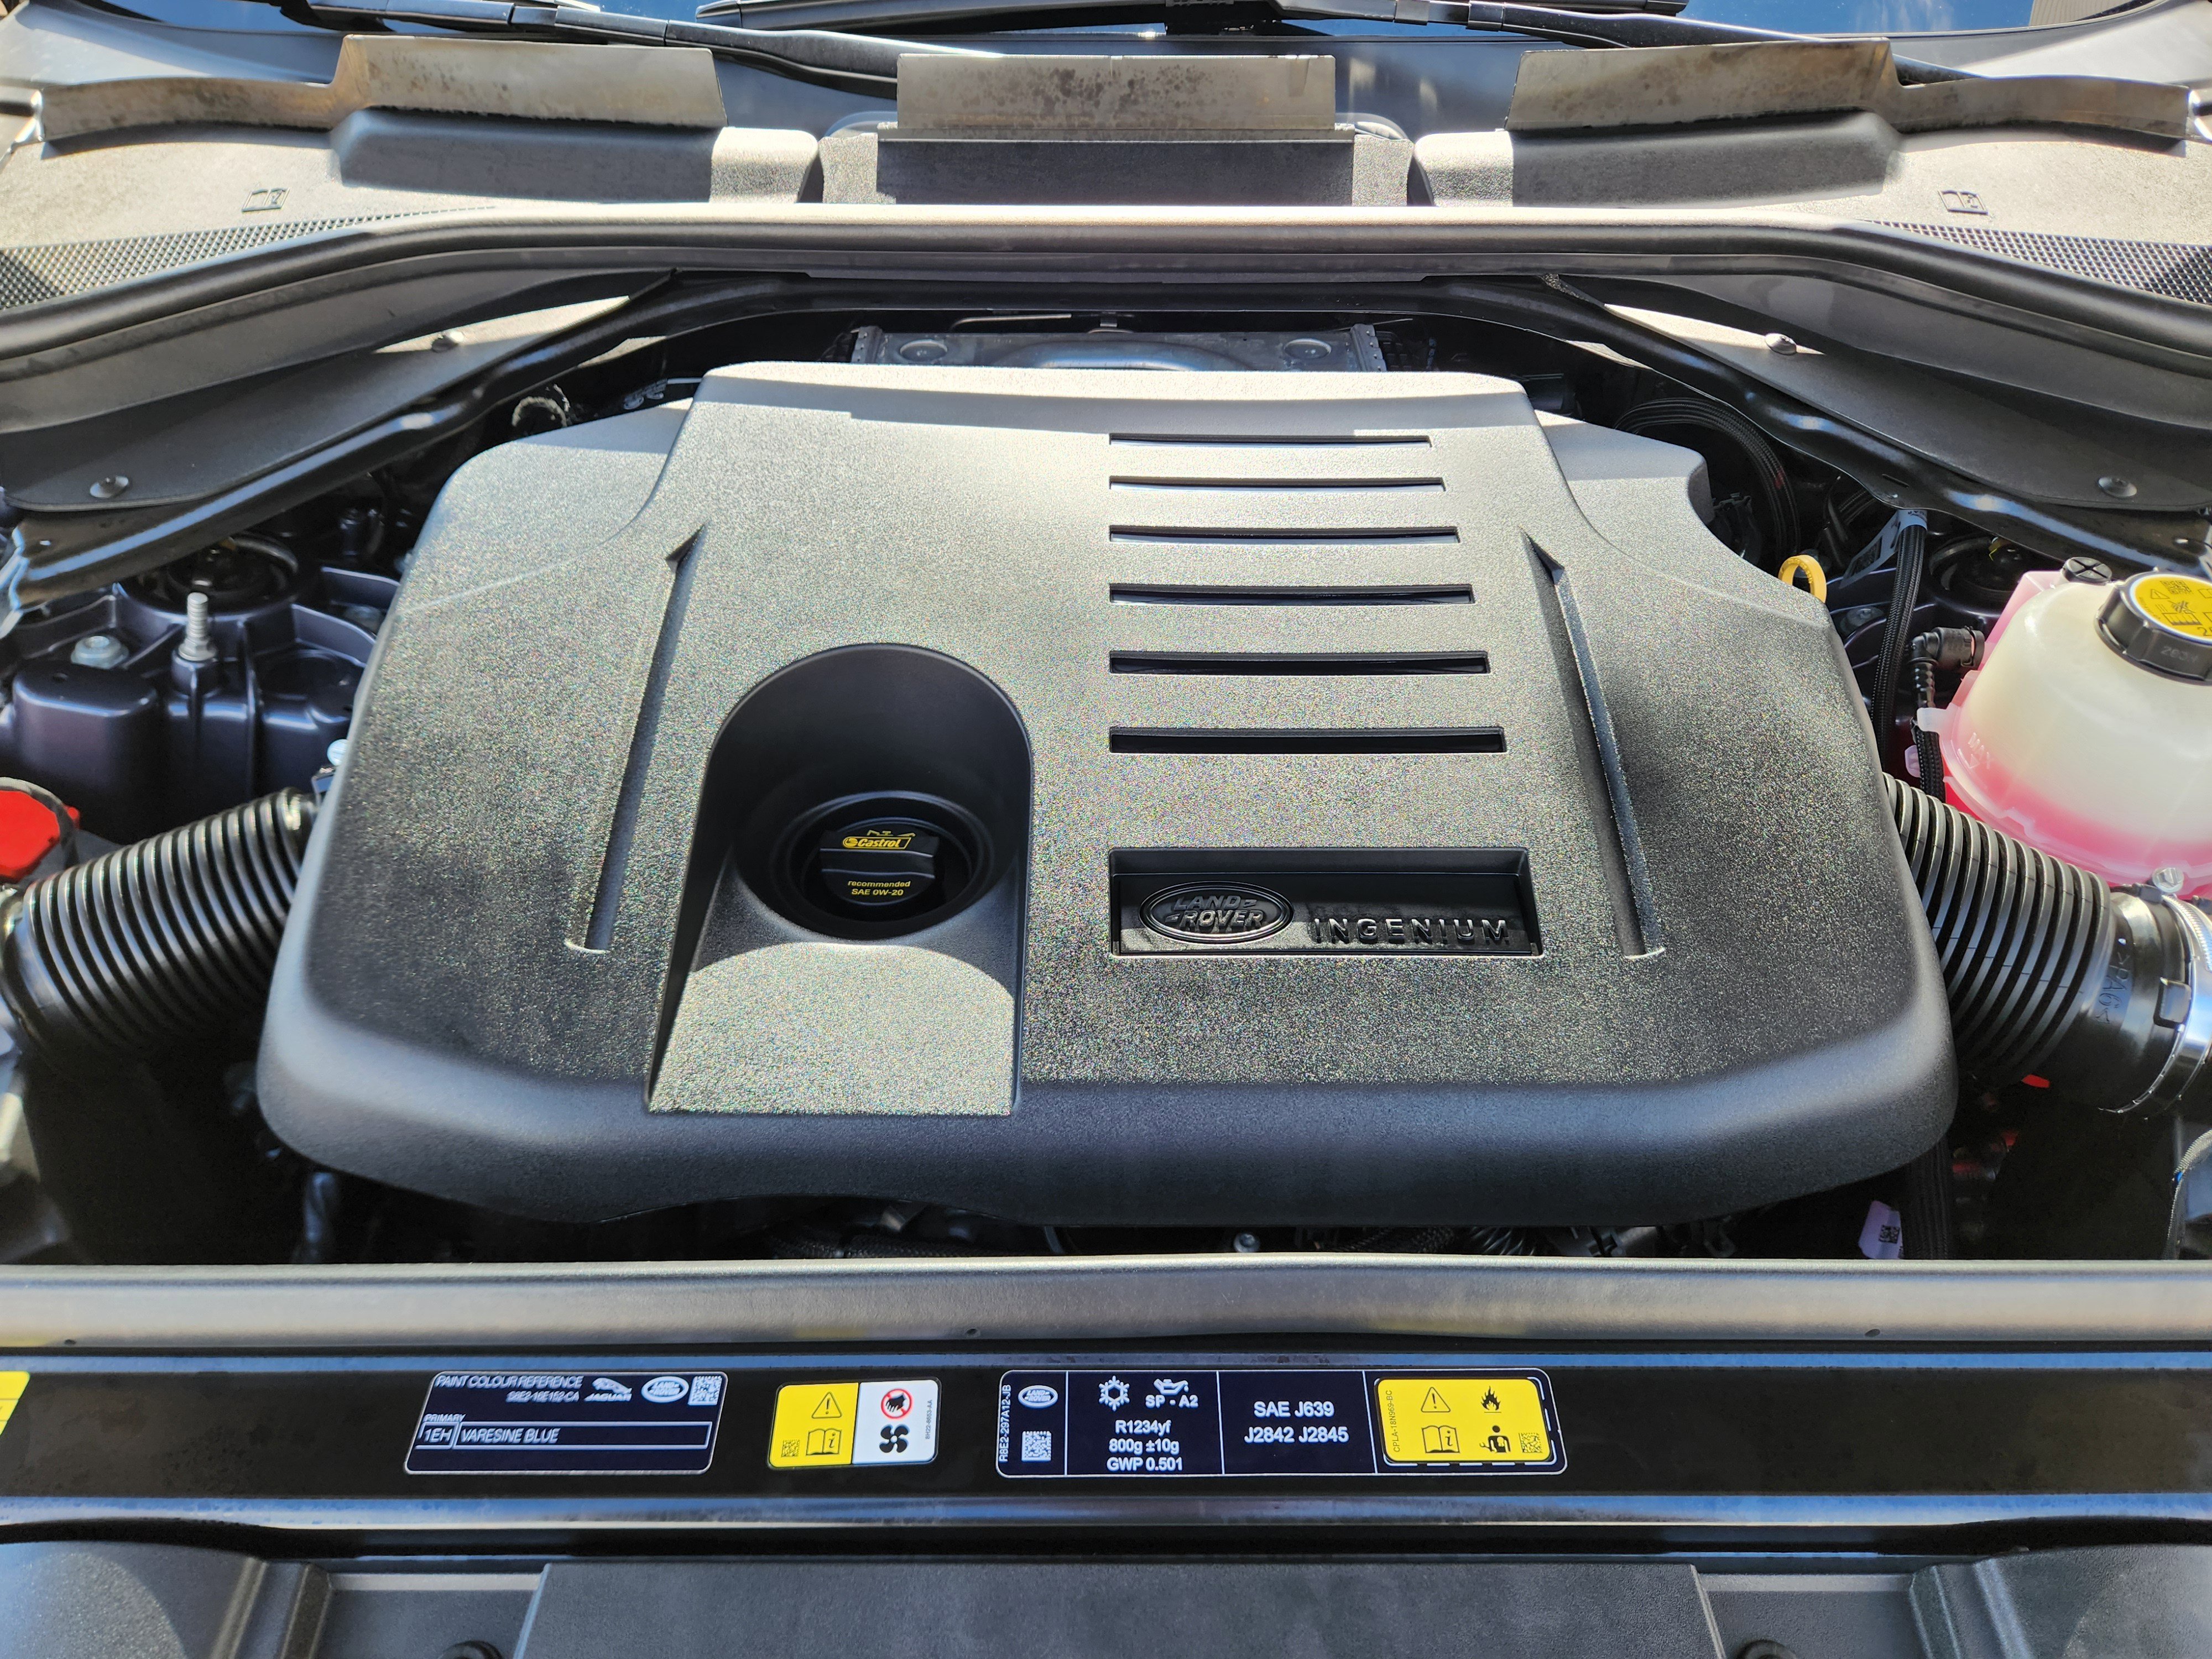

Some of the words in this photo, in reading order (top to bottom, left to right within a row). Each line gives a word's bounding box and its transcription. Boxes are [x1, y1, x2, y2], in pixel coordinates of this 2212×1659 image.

[857, 838, 900, 848] Castrol
[1173, 895, 1241, 910] LAND
[1179, 910, 1264, 927] ROVER
[1314, 918, 1509, 942] INGENIUM
[434, 1375, 469, 1388] PAINT
[467, 1375, 518, 1389] COLOUR
[515, 1375, 584, 1389] REFERENCE
[1145, 1395, 1165, 1408] SP
[1178, 1395, 1199, 1408] A2
[1254, 1401, 1291, 1417] SAE
[1294, 1401, 1335, 1417] J639
[999, 1384, 1011, 1462] R8E2-297A12-JB
[1115, 1420, 1171, 1437] R1234yf
[1385, 1390, 1400, 1453] CPLA-18N969-BC
[424, 1428, 453, 1442] 1EH
[460, 1428, 524, 1443] VARESINE
[523, 1428, 561, 1443] BLUE
[1244, 1426, 1295, 1443] J2842
[1298, 1426, 1349, 1443] J2845
[1109, 1438, 1143, 1455] 800g
[1145, 1438, 1180, 1455] ±10g
[1107, 1457, 1144, 1472] GWP
[1145, 1457, 1183, 1472] 0.501
